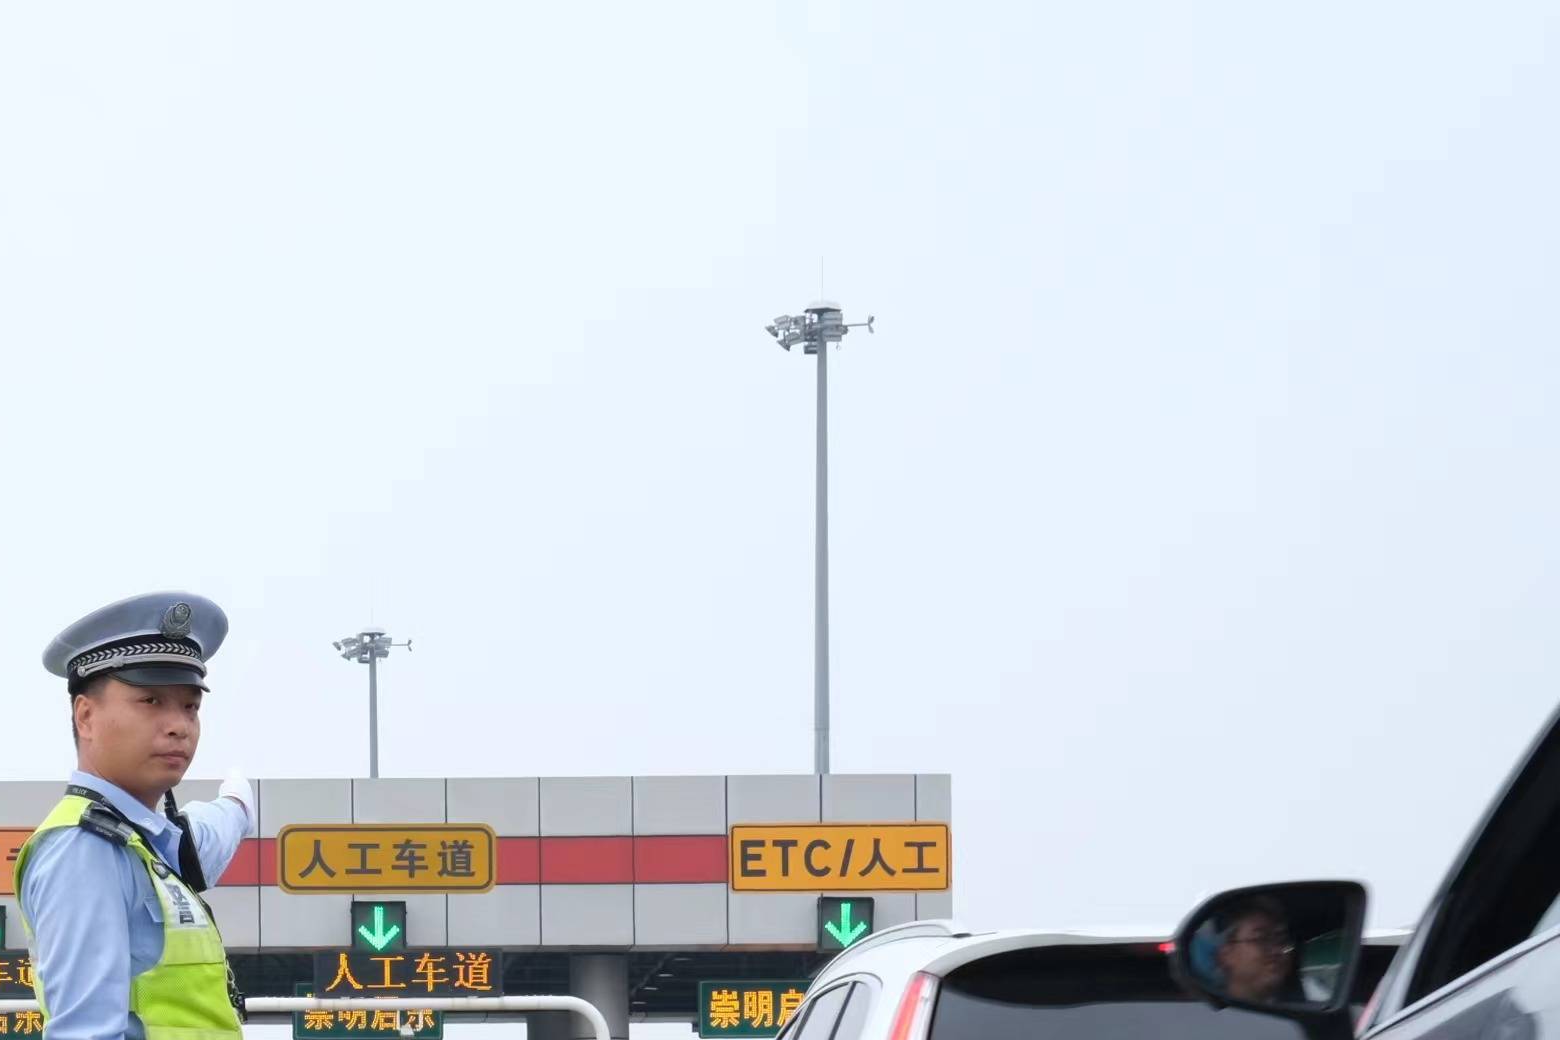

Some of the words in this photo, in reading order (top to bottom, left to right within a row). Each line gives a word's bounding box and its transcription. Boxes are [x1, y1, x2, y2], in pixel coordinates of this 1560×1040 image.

[298, 838, 476, 879] 人工车道
[740, 838, 940, 877] ETC/人工
[325, 952, 493, 992] 人工车道
